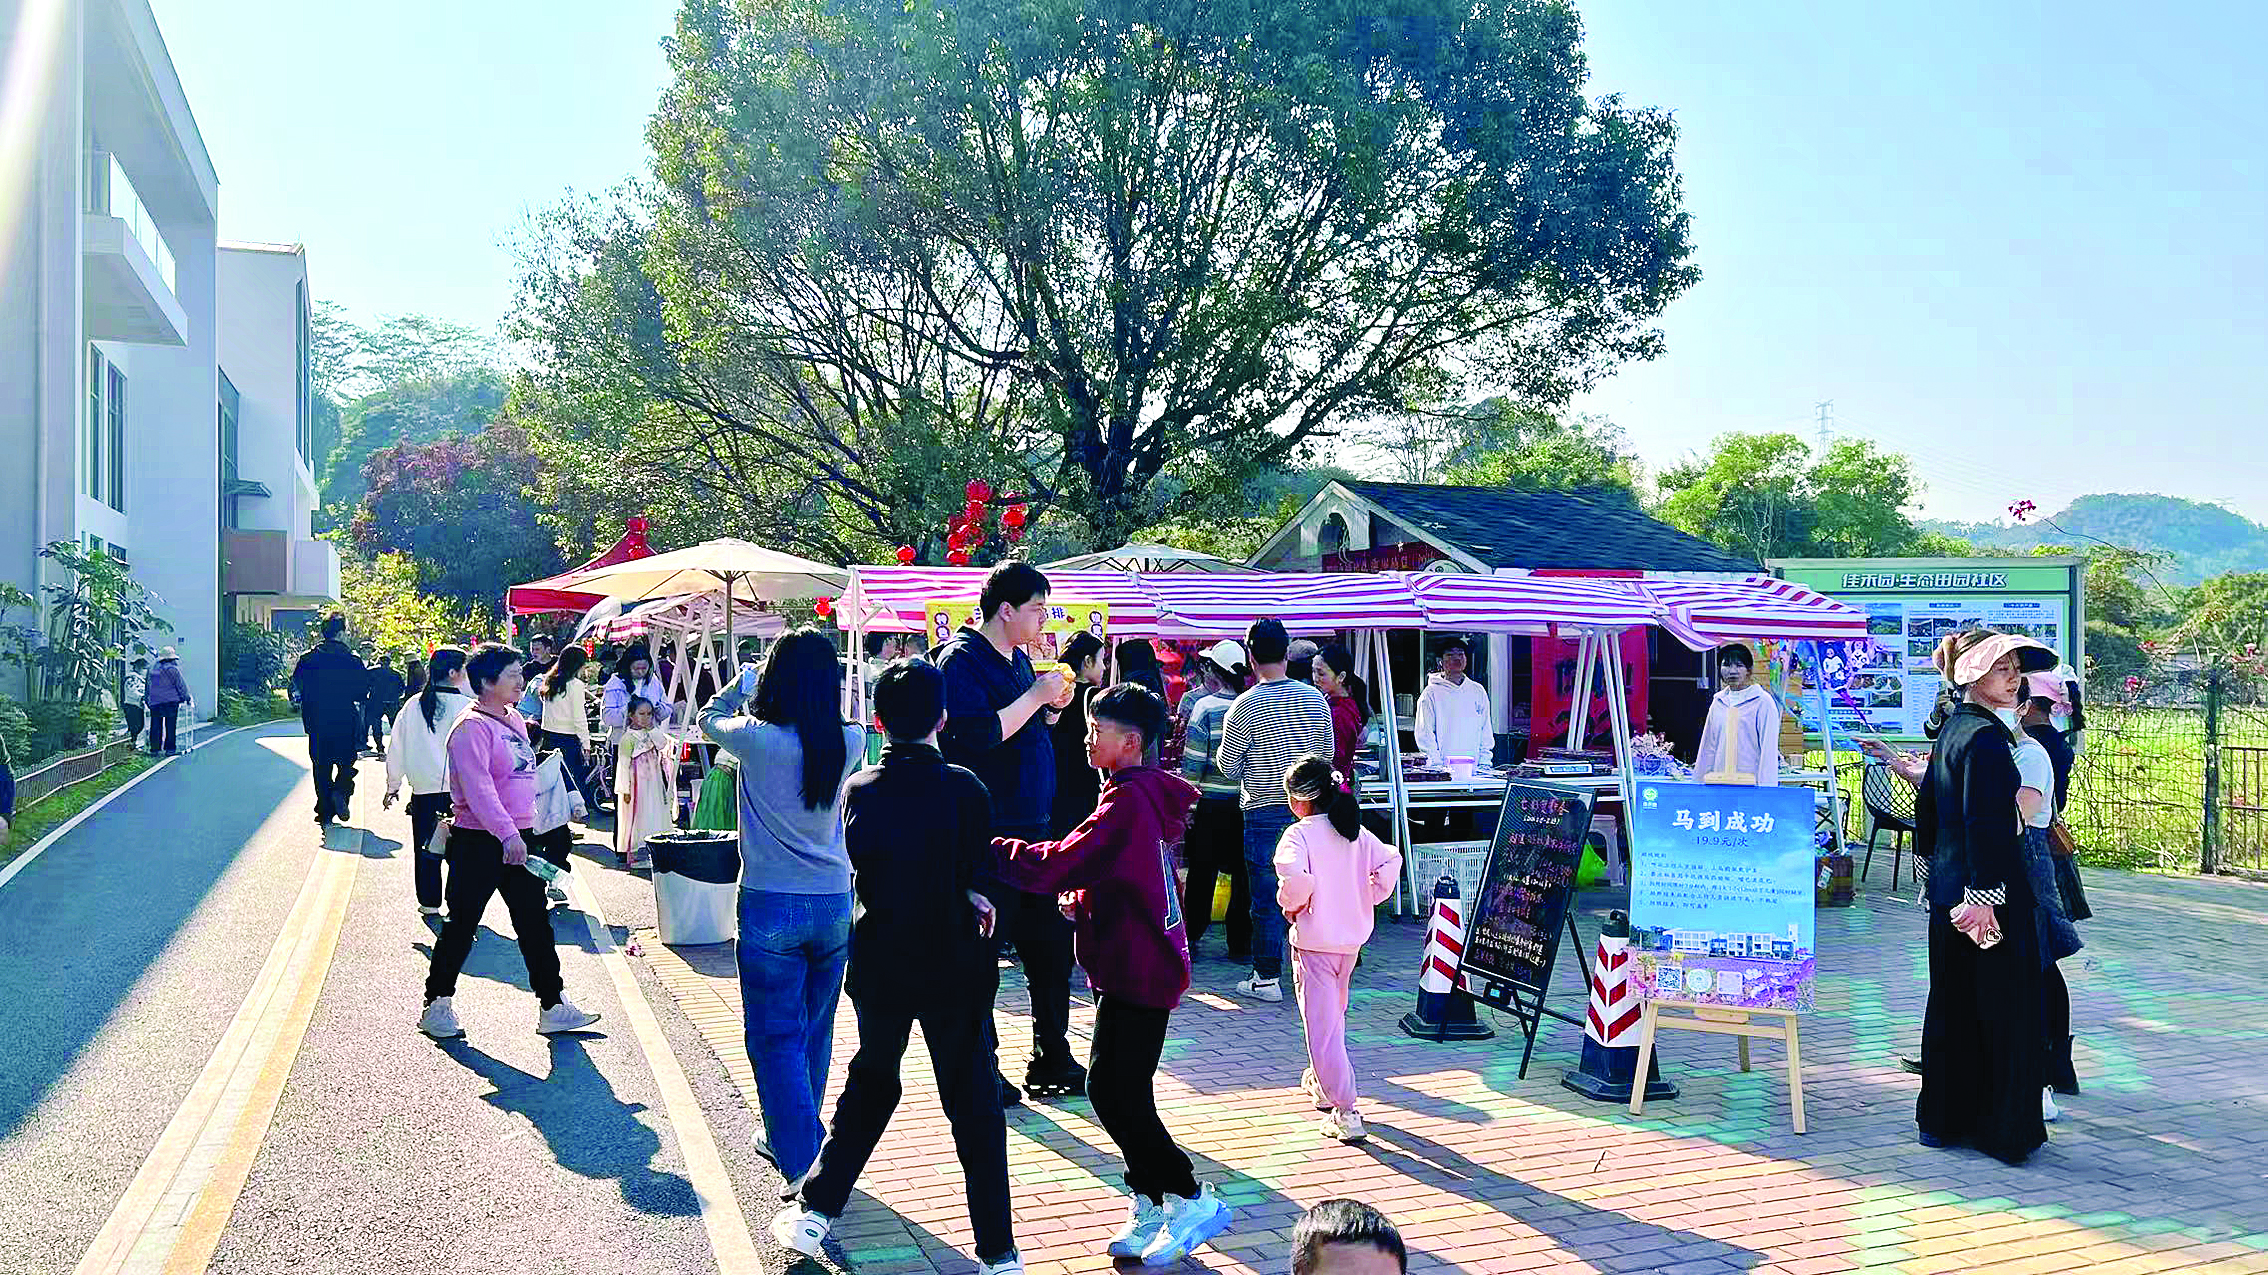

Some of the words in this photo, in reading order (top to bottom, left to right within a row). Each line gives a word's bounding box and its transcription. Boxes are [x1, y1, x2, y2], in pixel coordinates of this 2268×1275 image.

[1672, 809, 1776, 834] 马到成功
[1695, 835, 1750, 848] 19.9元/次
